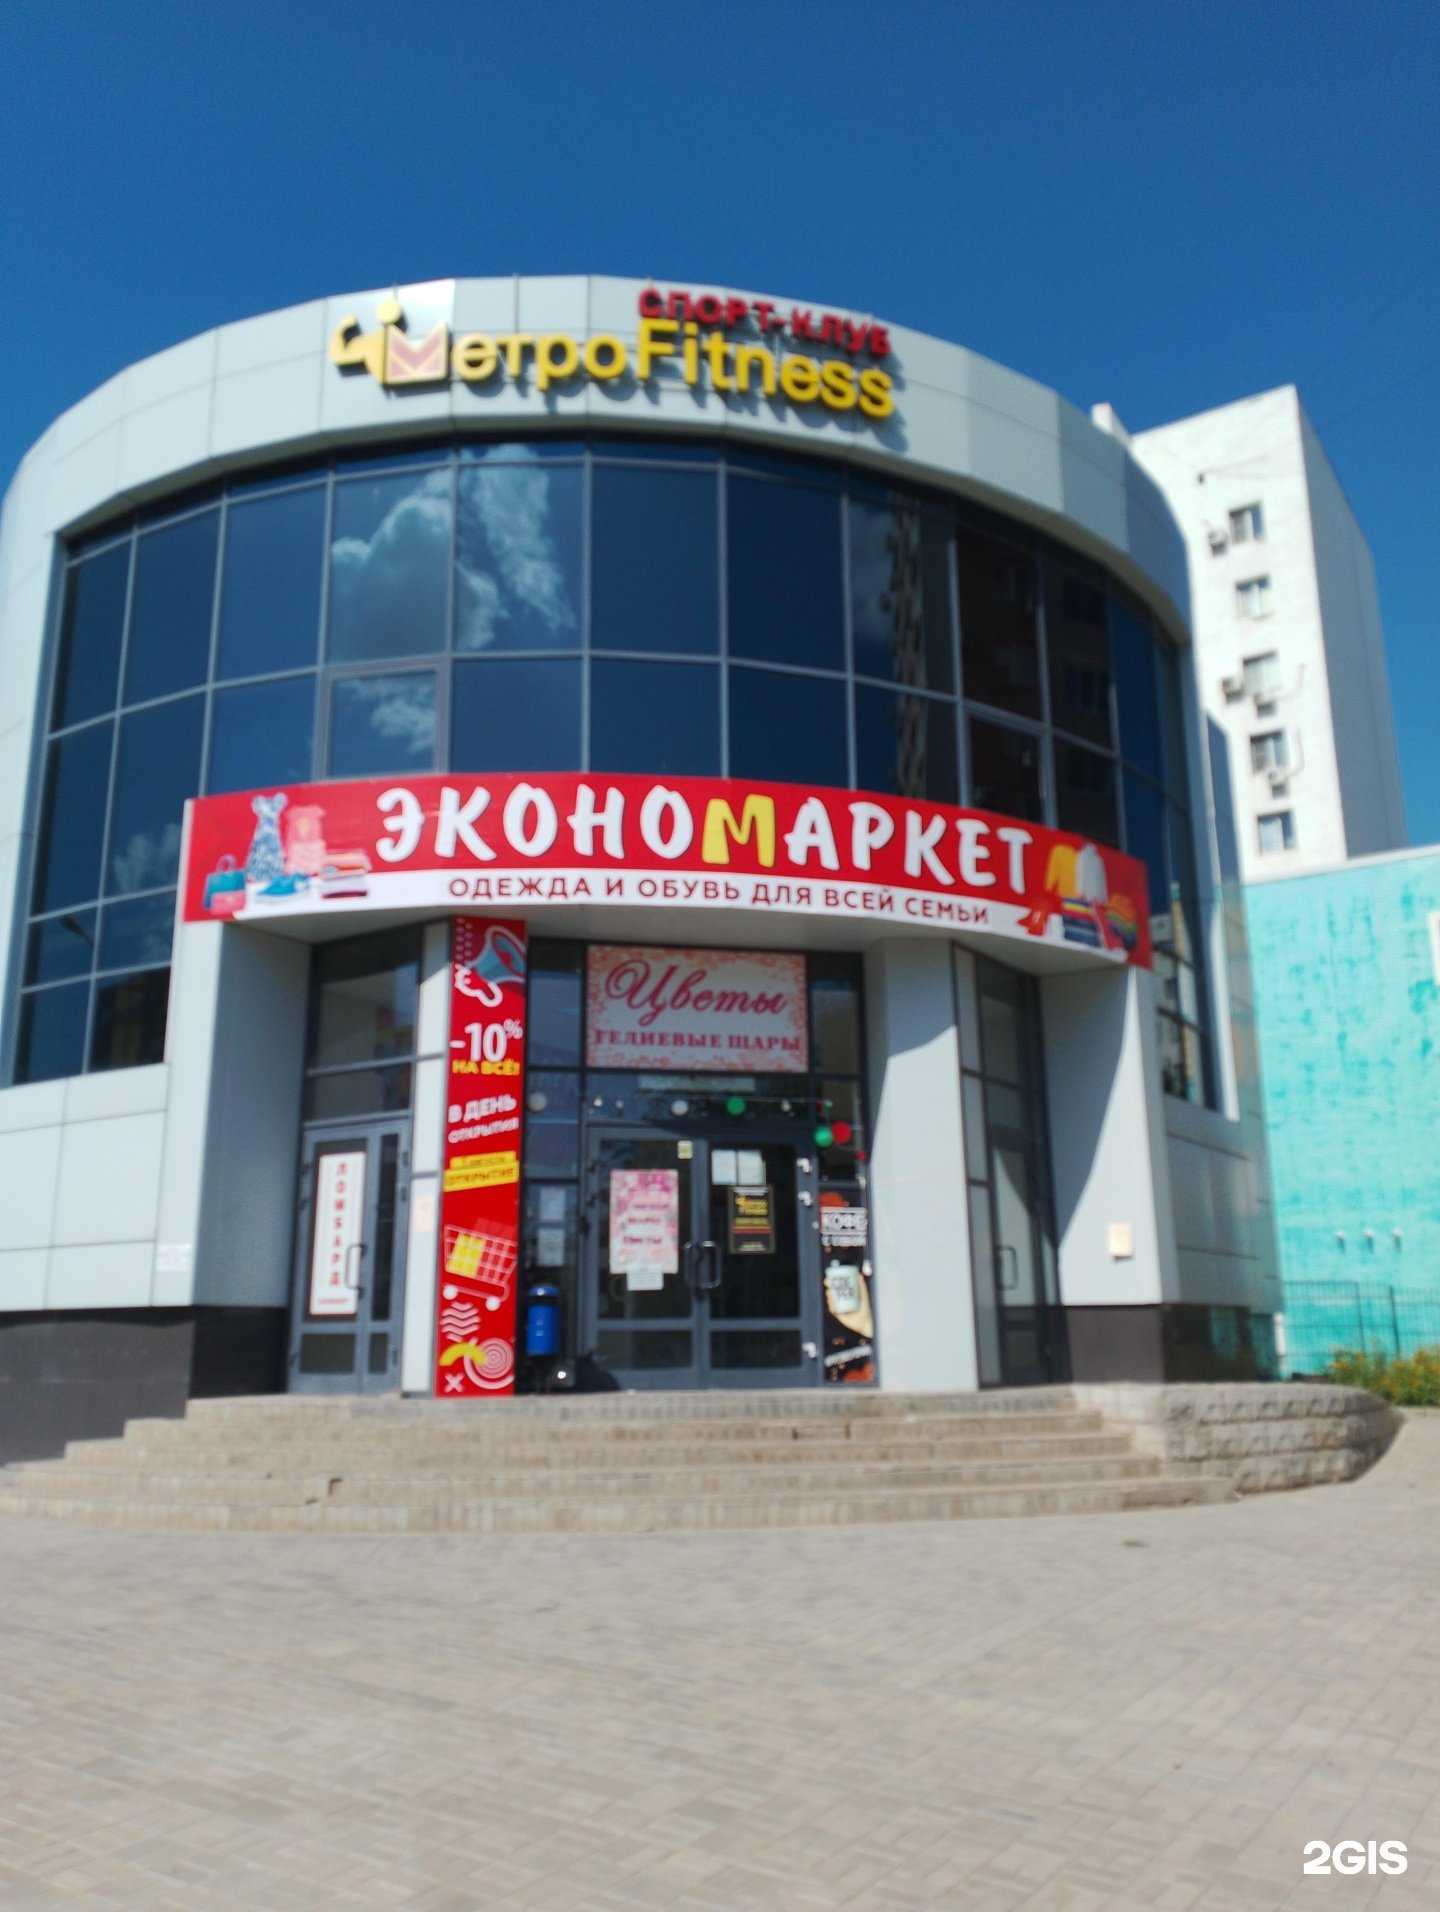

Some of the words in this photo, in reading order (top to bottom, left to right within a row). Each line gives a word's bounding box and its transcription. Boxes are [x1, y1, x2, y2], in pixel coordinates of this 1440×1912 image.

[639, 287, 892, 357] СПОРТ-КЛУБ
[375, 782, 1033, 895] ЭКОНОМАРКЕТ
[449, 877, 591, 900] ОДЕЖДА
[606, 877, 623, 898] И
[638, 879, 740, 900] ОБУВЬ
[752, 883, 811, 906] ДЛЯ
[825, 888, 894, 913] ВСЕЙ
[905, 897, 989, 924] СЕМЬИ
[605, 959, 787, 1027] Цветы
[449, 1019, 523, 1063] -10%
[593, 1029, 722, 1048] ГЕЛИЕВЫЕ
[728, 1033, 801, 1051] ШАРЫ
[452, 1060, 479, 1074] НА
[448, 1104, 462, 1123] В
[463, 1094, 517, 1123] ДЕНЬ
